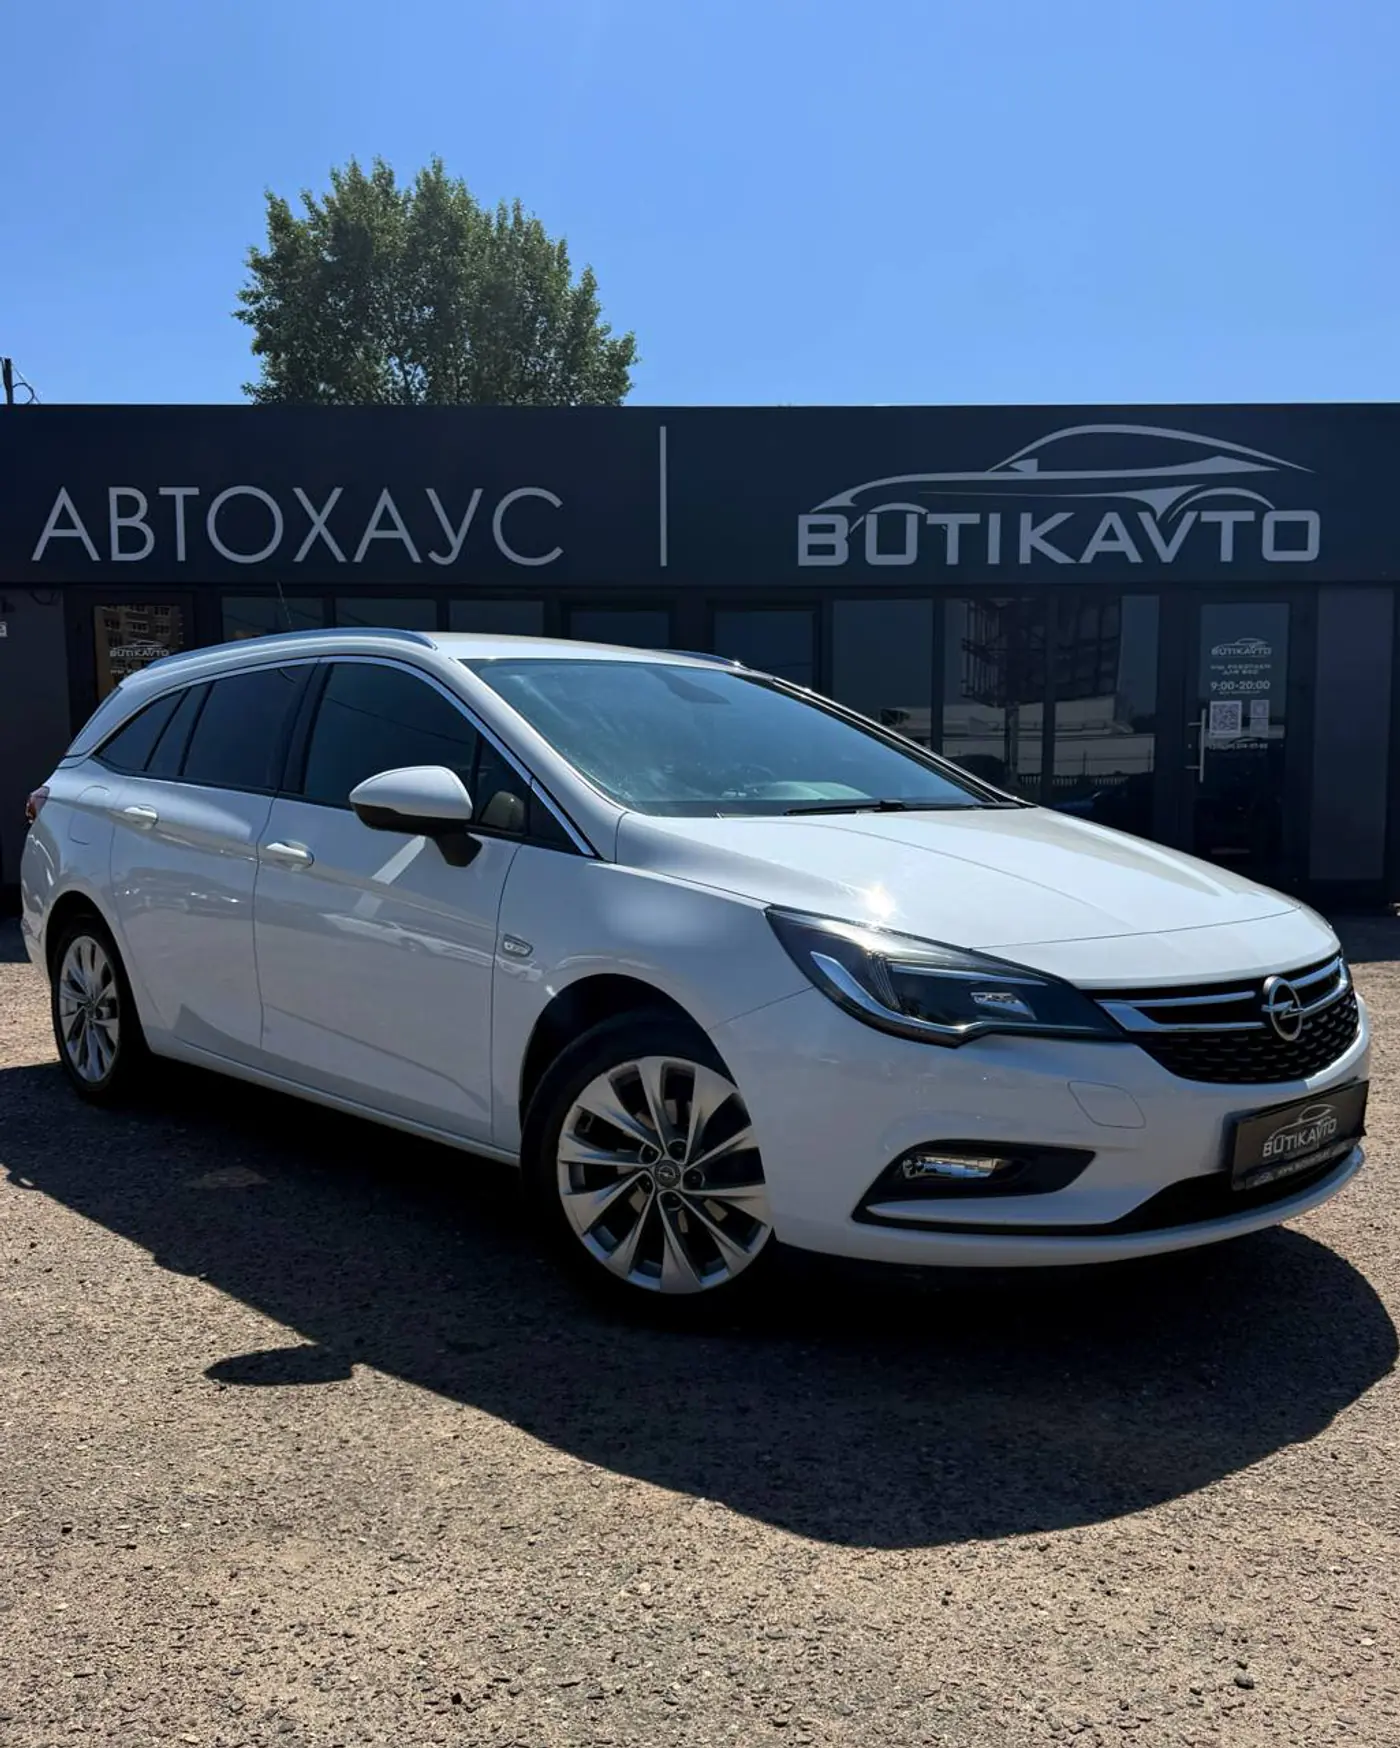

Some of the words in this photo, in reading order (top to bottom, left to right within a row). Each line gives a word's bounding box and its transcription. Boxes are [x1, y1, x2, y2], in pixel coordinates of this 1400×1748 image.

[32, 485, 564, 567] АВТОХАУС
[798, 509, 1320, 566] BUTIKAVTO
[109, 649, 170, 657] BUTIKAVTO
[1210, 647, 1272, 656] BUTIKAVTO
[1210, 680, 1271, 691] 9:00-20:00
[1262, 1117, 1337, 1158] BUTIKAVTO
